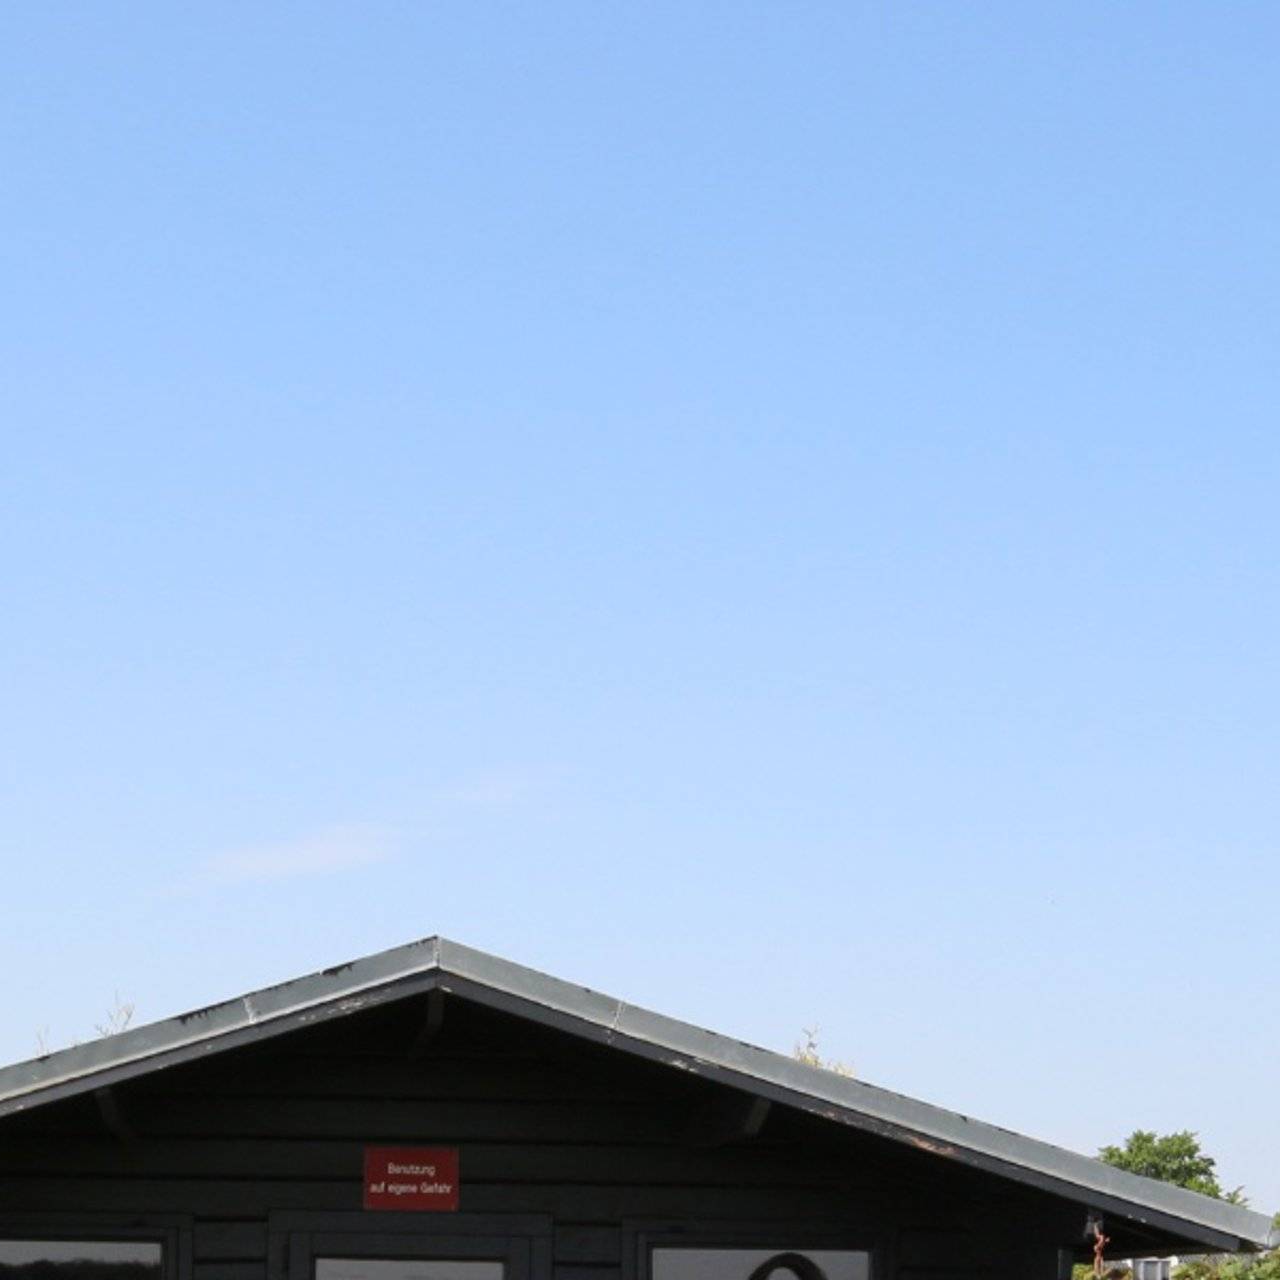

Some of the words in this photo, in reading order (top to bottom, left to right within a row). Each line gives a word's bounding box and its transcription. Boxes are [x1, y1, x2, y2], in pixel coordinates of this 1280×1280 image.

[388, 1162, 435, 1177] Benutzung
[370, 1182, 384, 1193] auf
[388, 1184, 417, 1195] eigene
[420, 1182, 452, 1193] Gefahr
